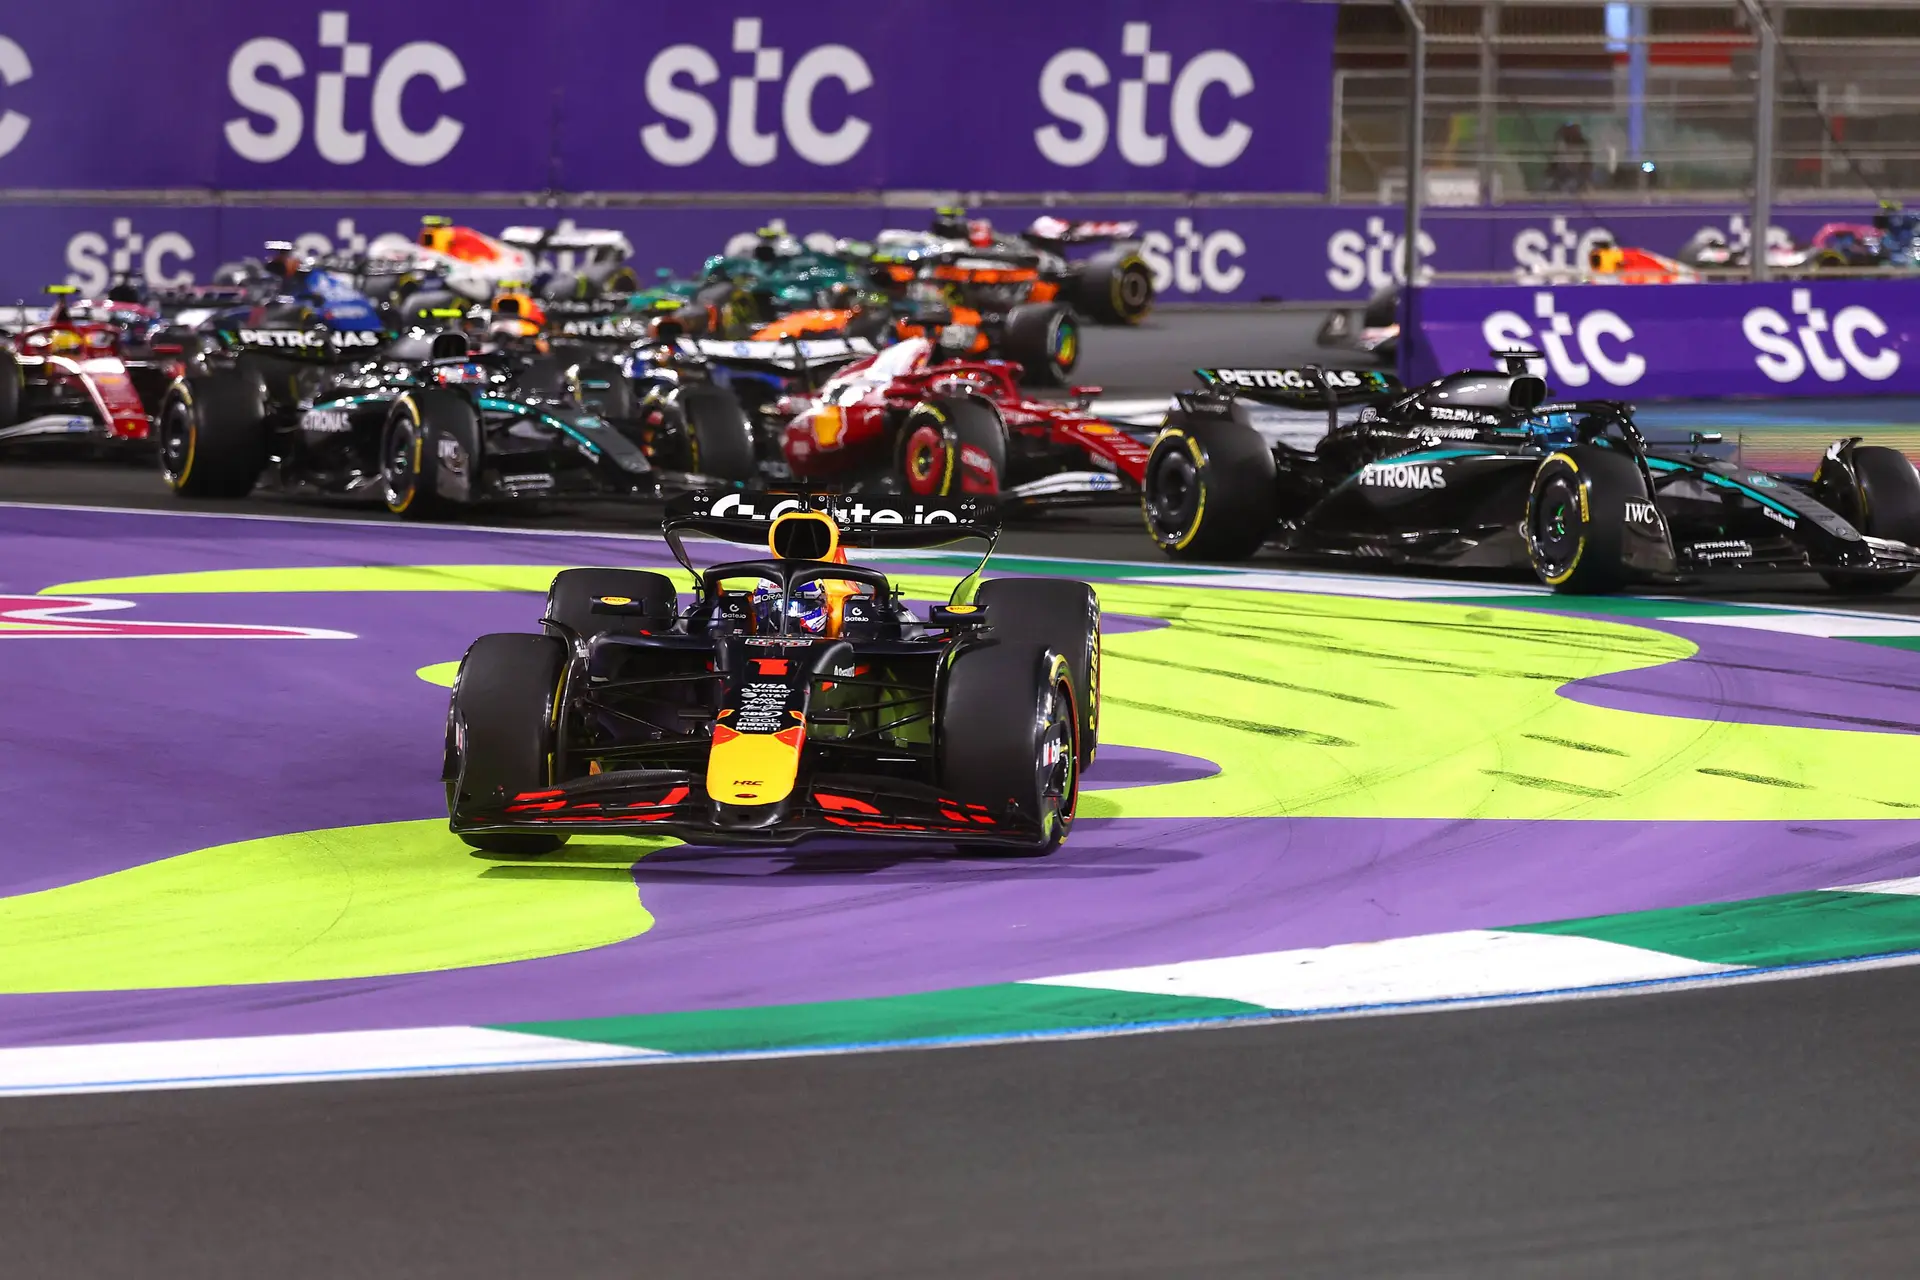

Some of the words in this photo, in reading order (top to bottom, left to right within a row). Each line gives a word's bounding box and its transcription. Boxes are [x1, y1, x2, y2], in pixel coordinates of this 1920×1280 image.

[223, 11, 467, 165] stc
[640, 17, 874, 166] stc
[1034, 21, 1255, 167] stc
[66, 217, 195, 299] stc
[1139, 217, 1246, 293] stc
[1326, 216, 1436, 291] stc
[1482, 292, 1646, 387] stc
[1741, 289, 1901, 383] stc
[1216, 369, 1362, 387] PETROAS
[1358, 466, 1447, 490] PETRONAS
[1624, 502, 1655, 524] IWC
[1694, 540, 1747, 550] PETRONAS
